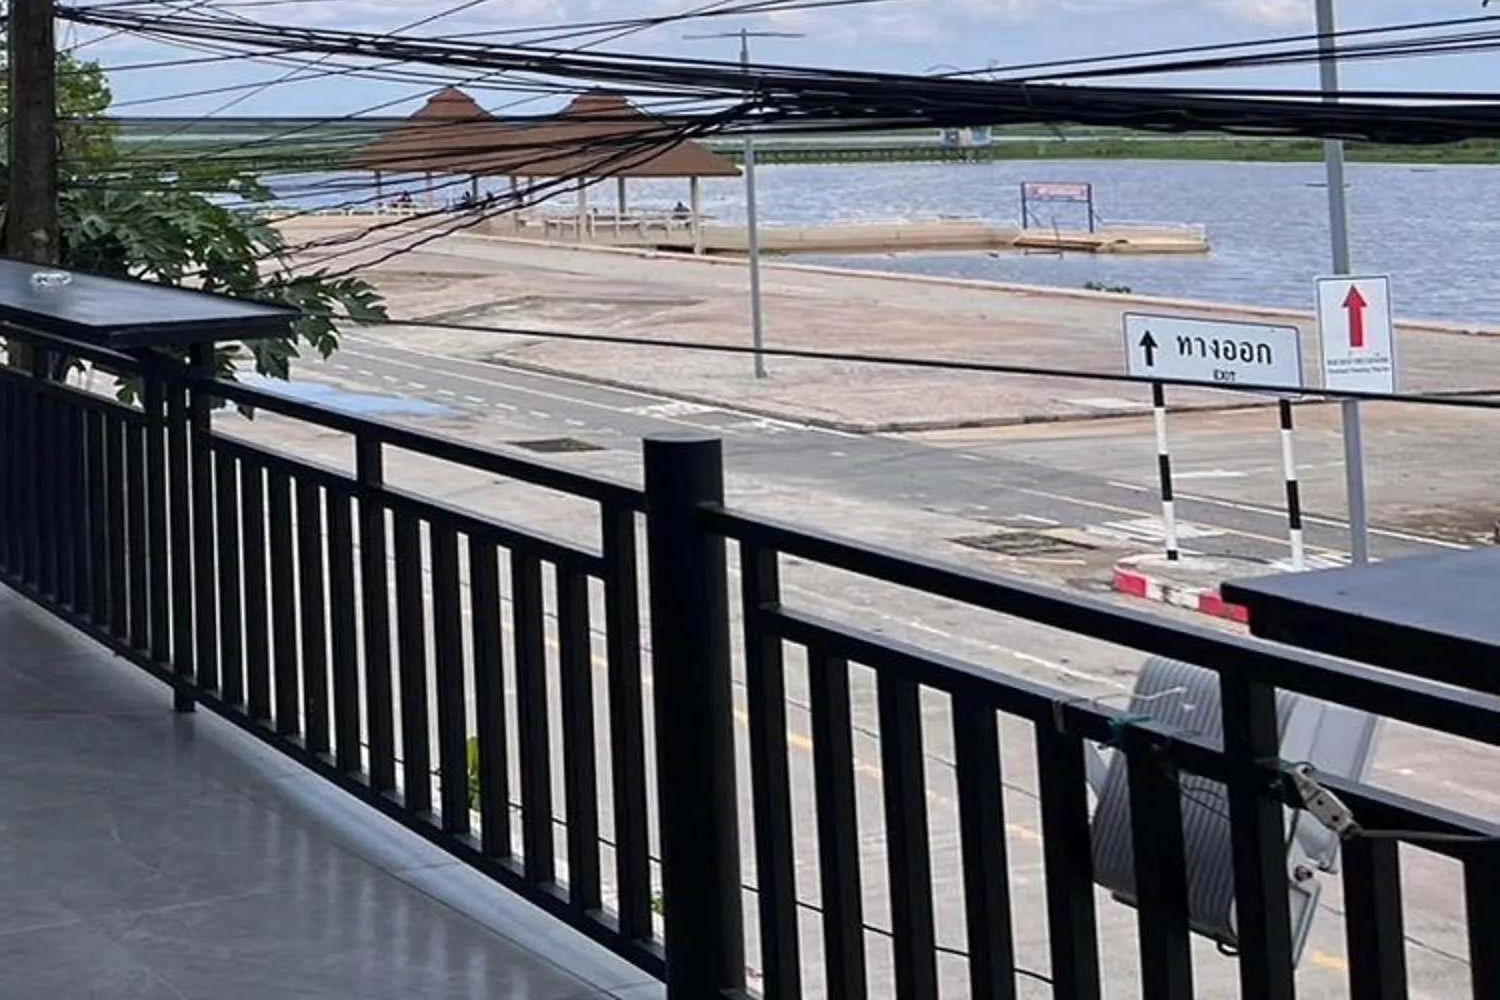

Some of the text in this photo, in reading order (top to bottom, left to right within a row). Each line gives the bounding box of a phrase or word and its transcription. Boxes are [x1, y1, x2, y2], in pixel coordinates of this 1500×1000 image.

[1176, 335, 1273, 365] ทางออก
[1213, 369, 1237, 381] EXIT
